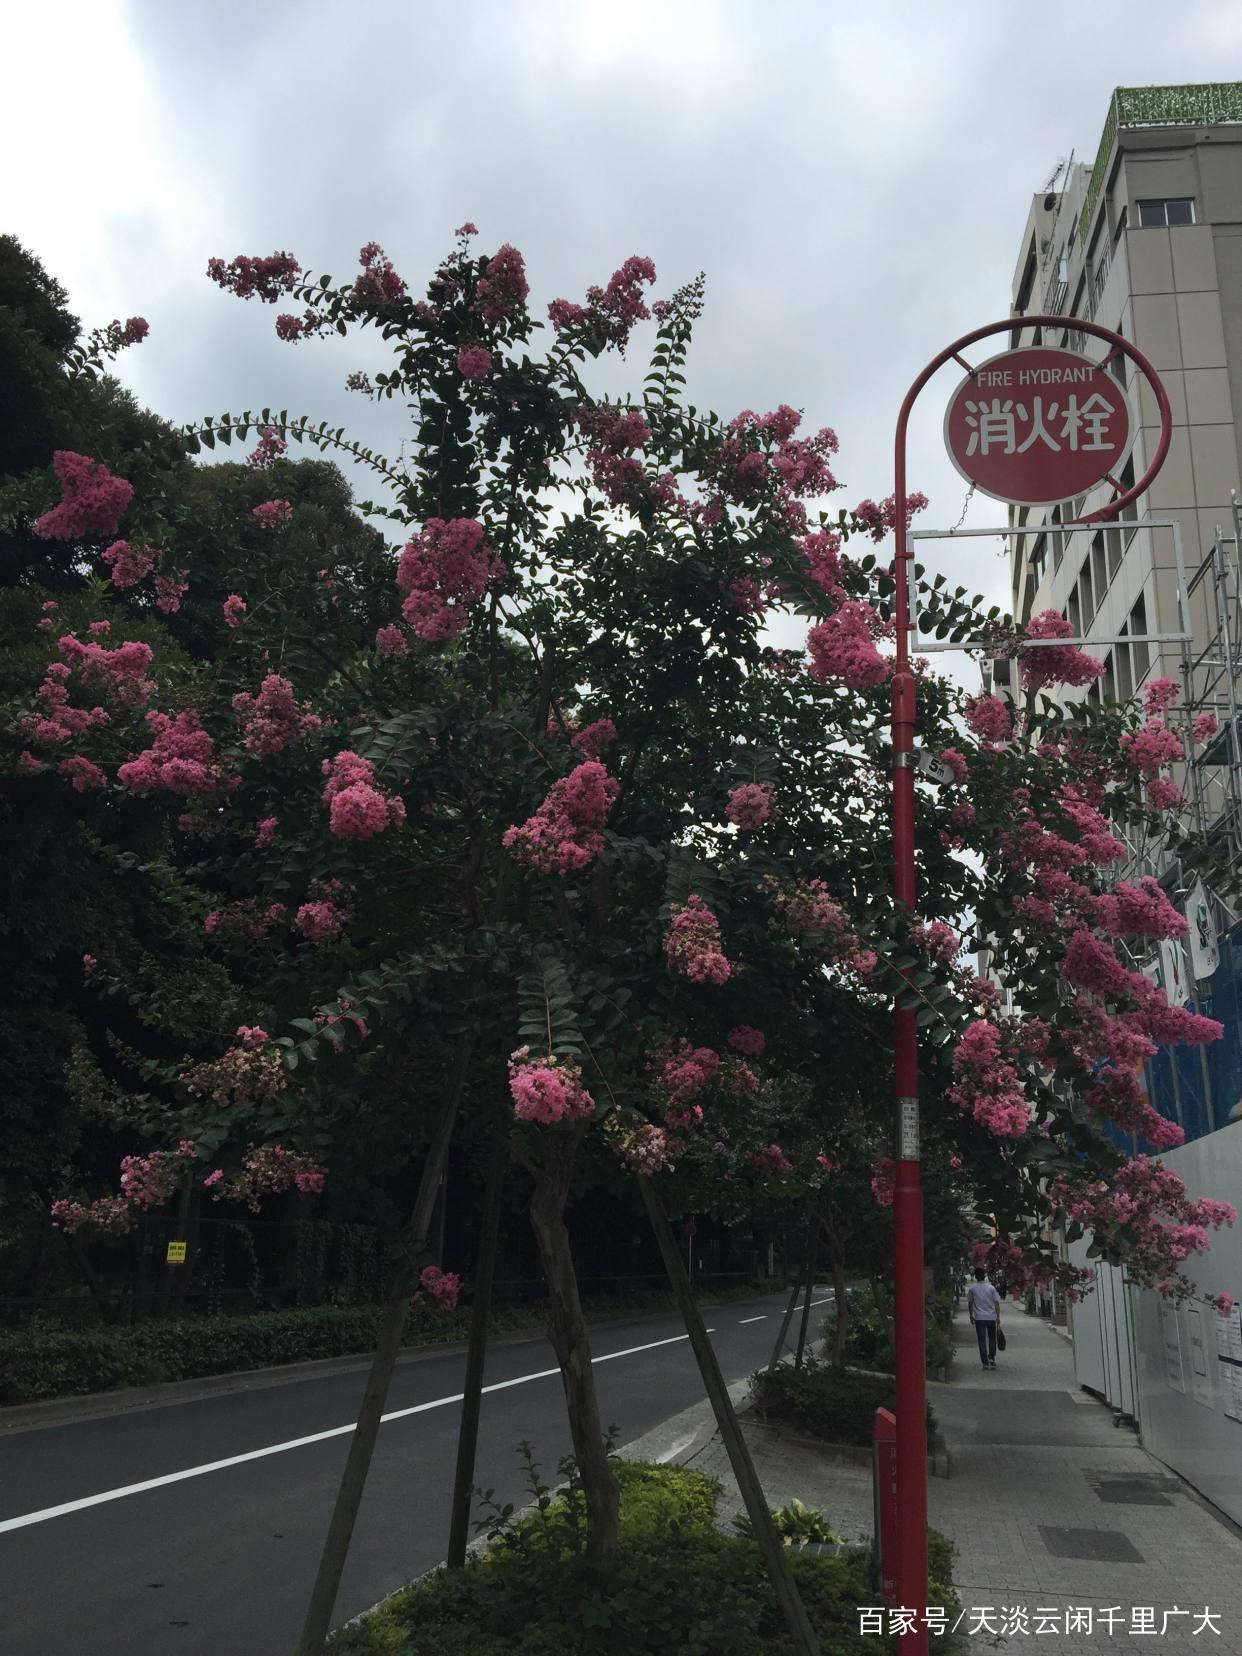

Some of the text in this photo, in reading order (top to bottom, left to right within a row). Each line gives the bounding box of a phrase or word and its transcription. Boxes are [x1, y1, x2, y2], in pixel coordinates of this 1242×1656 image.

[977, 366, 1096, 388] FIRE HYDRANT
[965, 393, 1116, 456] 消火栓
